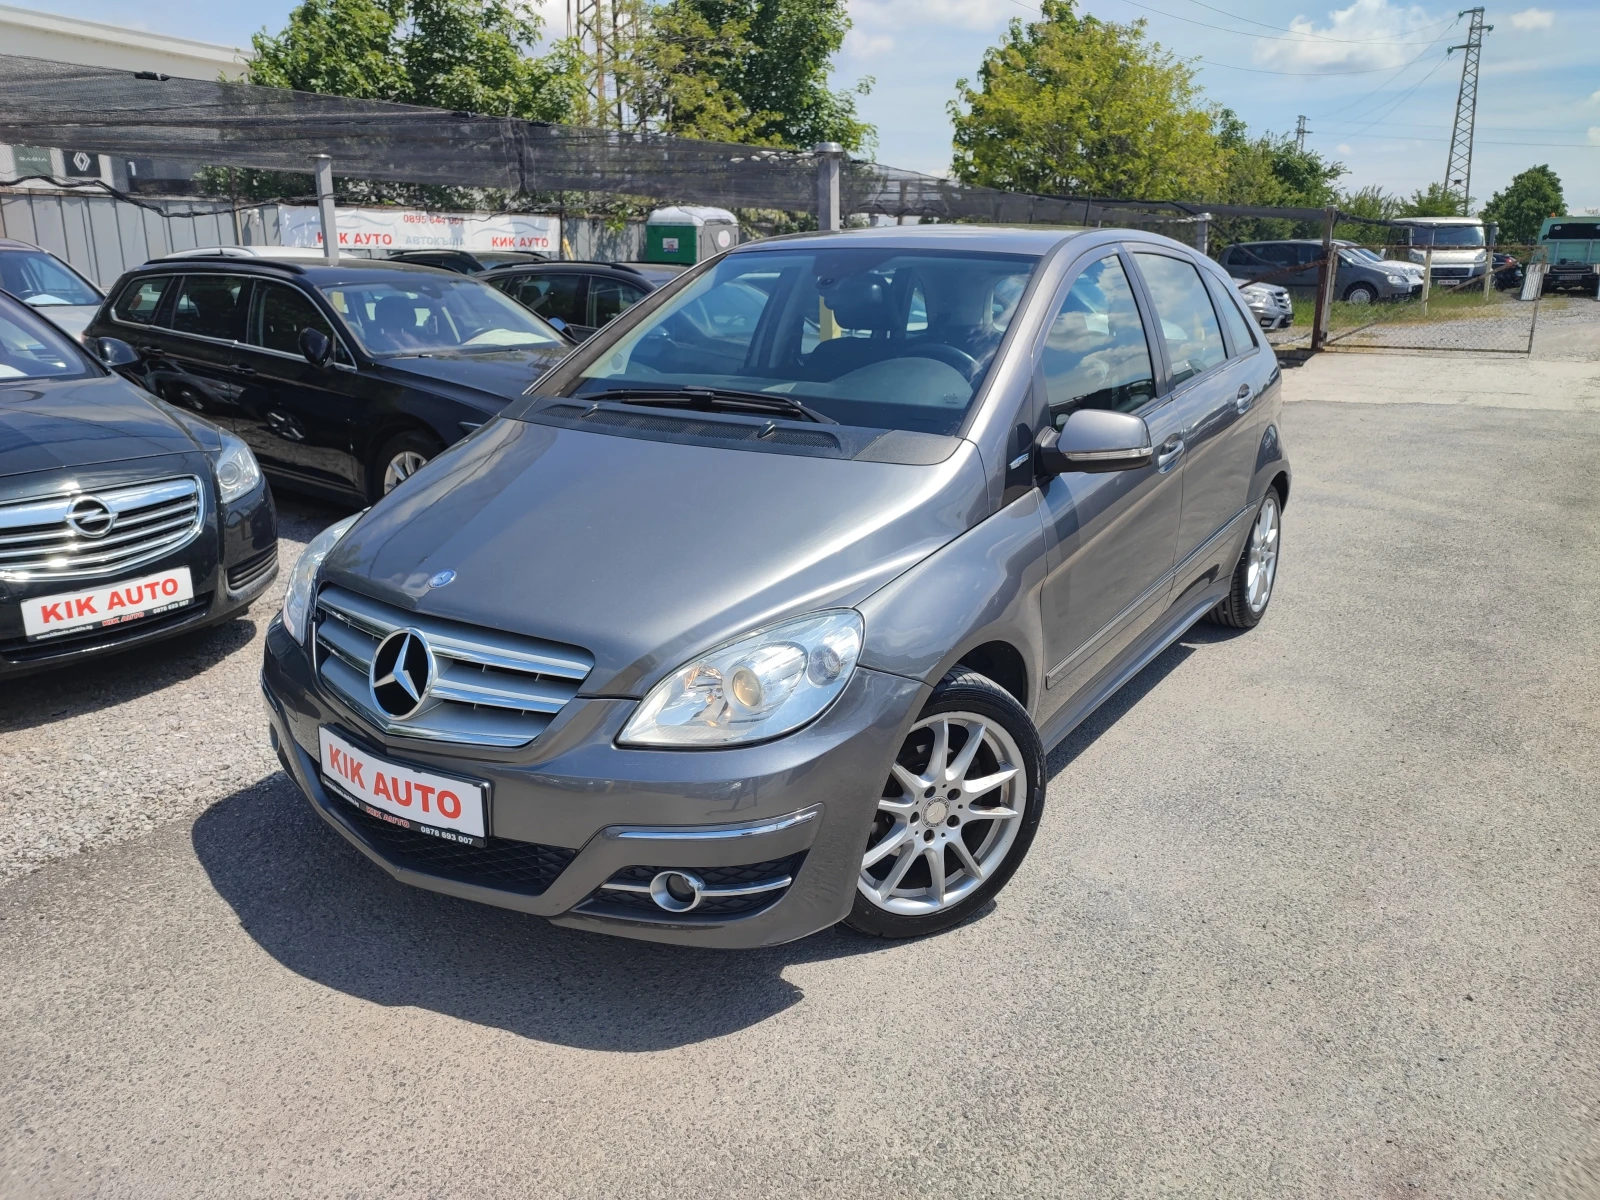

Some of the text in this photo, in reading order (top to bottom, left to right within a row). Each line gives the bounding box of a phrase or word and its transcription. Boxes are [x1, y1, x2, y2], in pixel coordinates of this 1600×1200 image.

[403, 214, 427, 224] 0895
[317, 232, 393, 245] КК АУТО
[492, 236, 549, 248] КИК АУТО
[40, 578, 179, 624] KIK AUTO
[121, 611, 145, 623] AUTO
[328, 743, 366, 790] KIK
[373, 771, 462, 819] AUTO
[365, 805, 473, 845] KIK AUTO 0878 693 007
